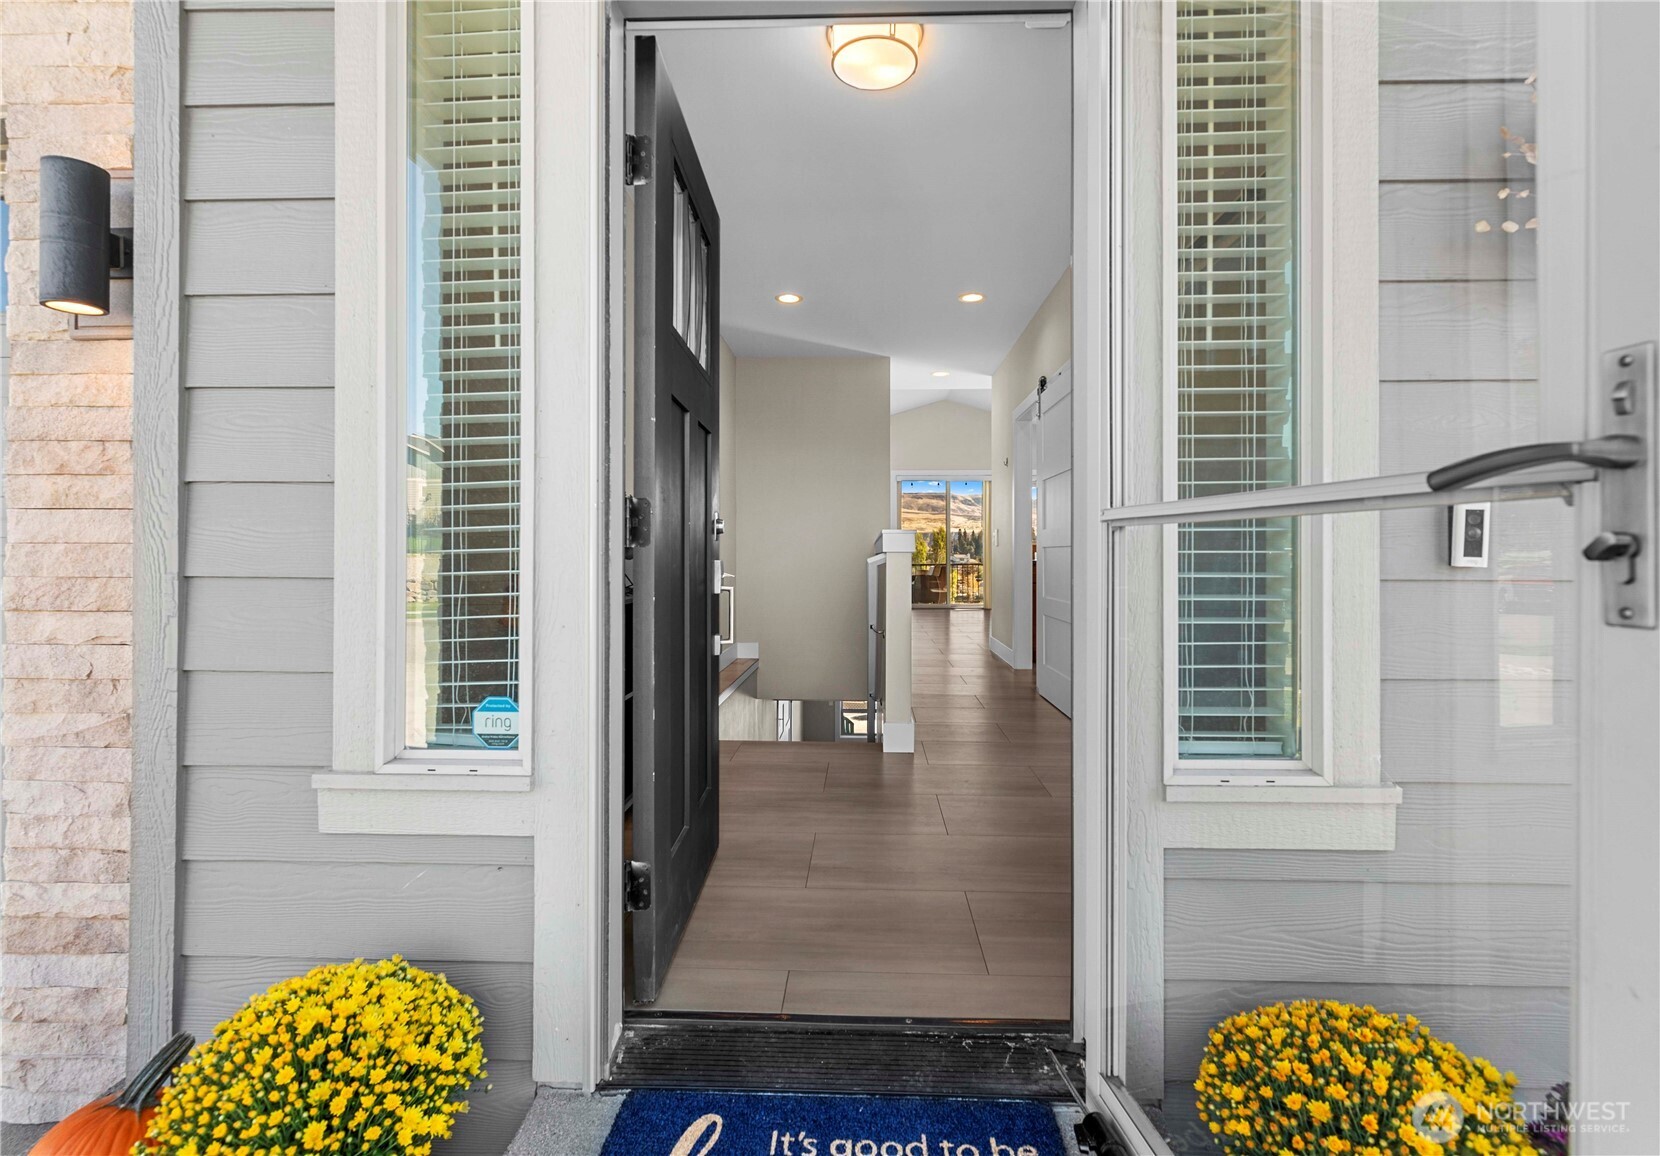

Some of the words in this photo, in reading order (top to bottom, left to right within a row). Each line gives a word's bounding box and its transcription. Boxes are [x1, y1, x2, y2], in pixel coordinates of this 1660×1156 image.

[484, 715, 511, 731] ring
[769, 1130, 818, 1156] It's
[939, 1140, 980, 1156] to
